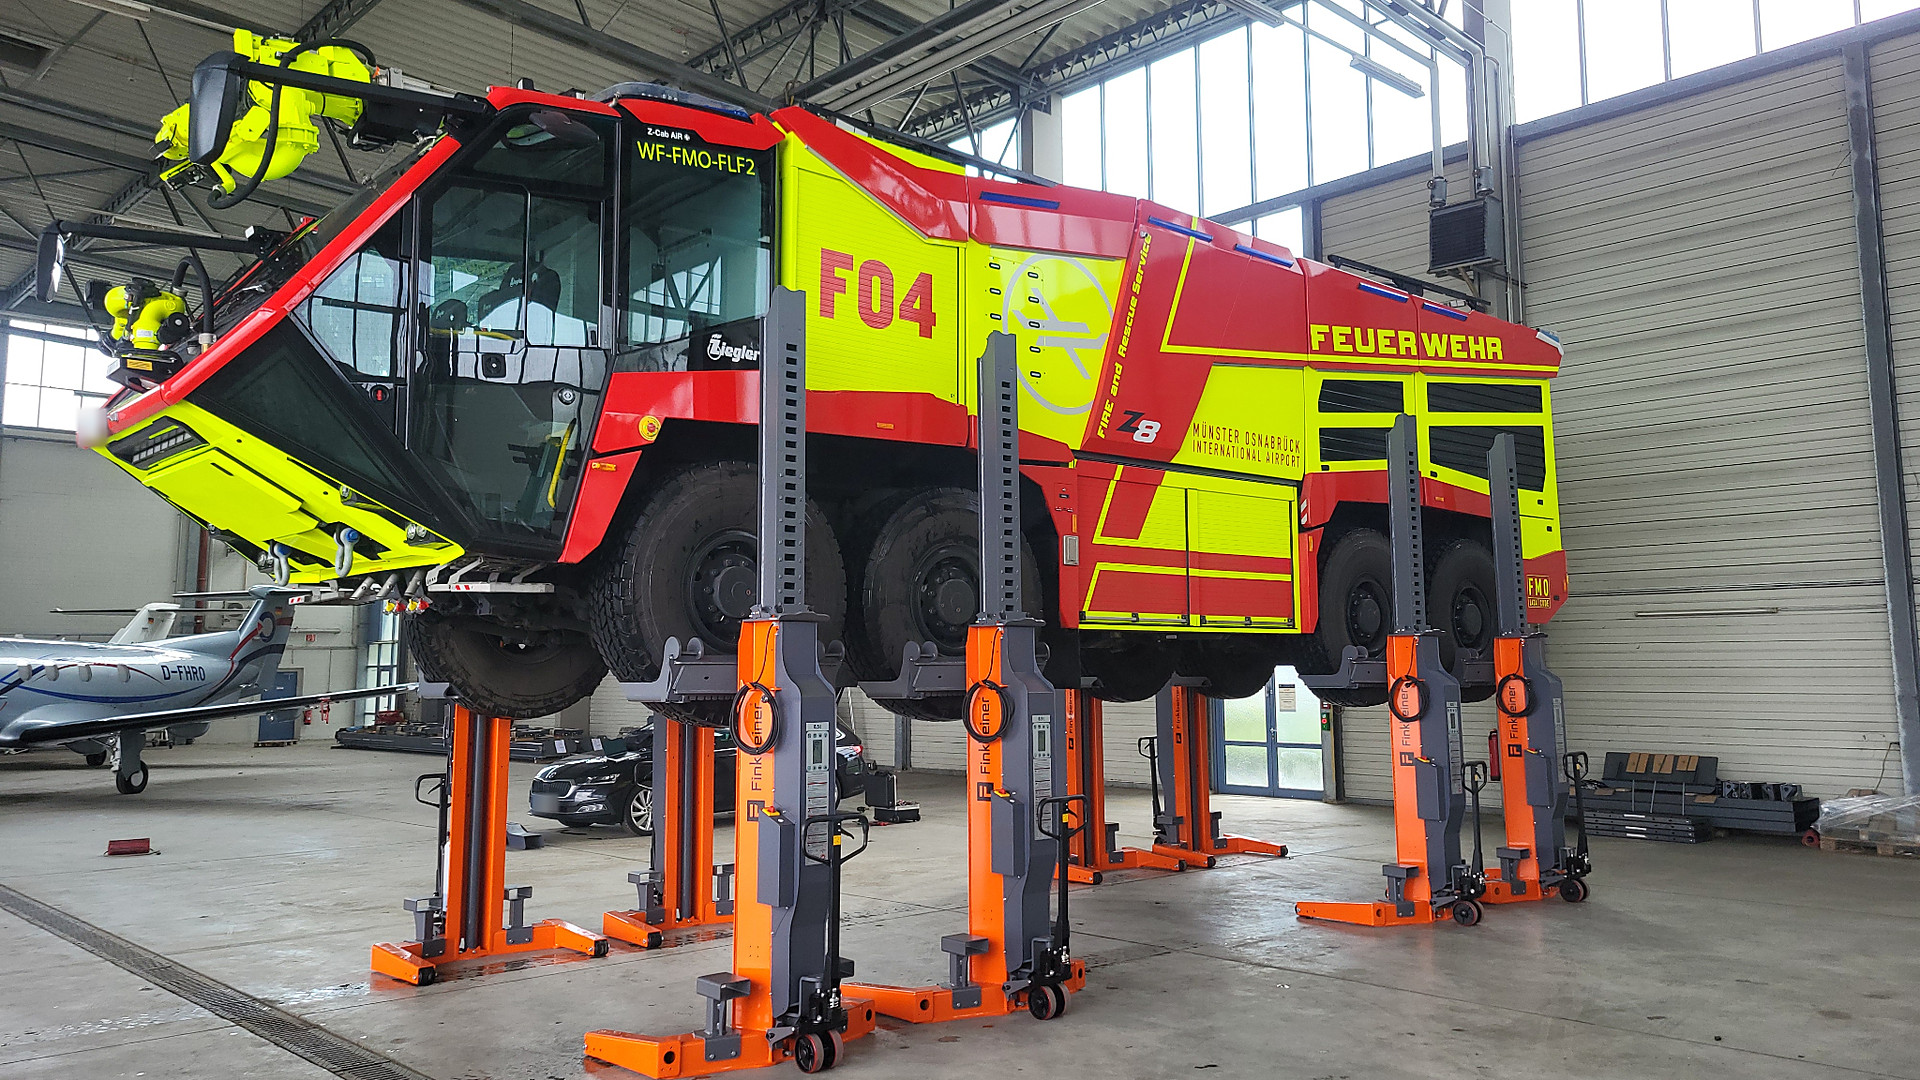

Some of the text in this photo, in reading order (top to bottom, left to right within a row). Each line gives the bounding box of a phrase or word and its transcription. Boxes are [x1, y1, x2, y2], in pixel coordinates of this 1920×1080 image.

[647, 127, 669, 139] Z-Cab
[637, 141, 756, 176] WF-FMO-FLF2
[707, 333, 760, 363] Ziegler
[1097, 232, 1152, 439] FIRE and Rescue Service
[1310, 324, 1503, 360] FEUERWEHR
[1116, 410, 1161, 443] Z8
[1193, 421, 1301, 454] MÜNSTER OSNABRÜCK
[1192, 439, 1300, 468] INTERNATIONAL AIRPORT
[1528, 577, 1549, 597] FMO
[160, 664, 205, 681] D-FHRO
[1400, 687, 1411, 747] Finkeiner
[1507, 685, 1519, 740] Finkeiner
[749, 702, 763, 791] Finkeiner
[978, 696, 991, 775] Finkeiner
